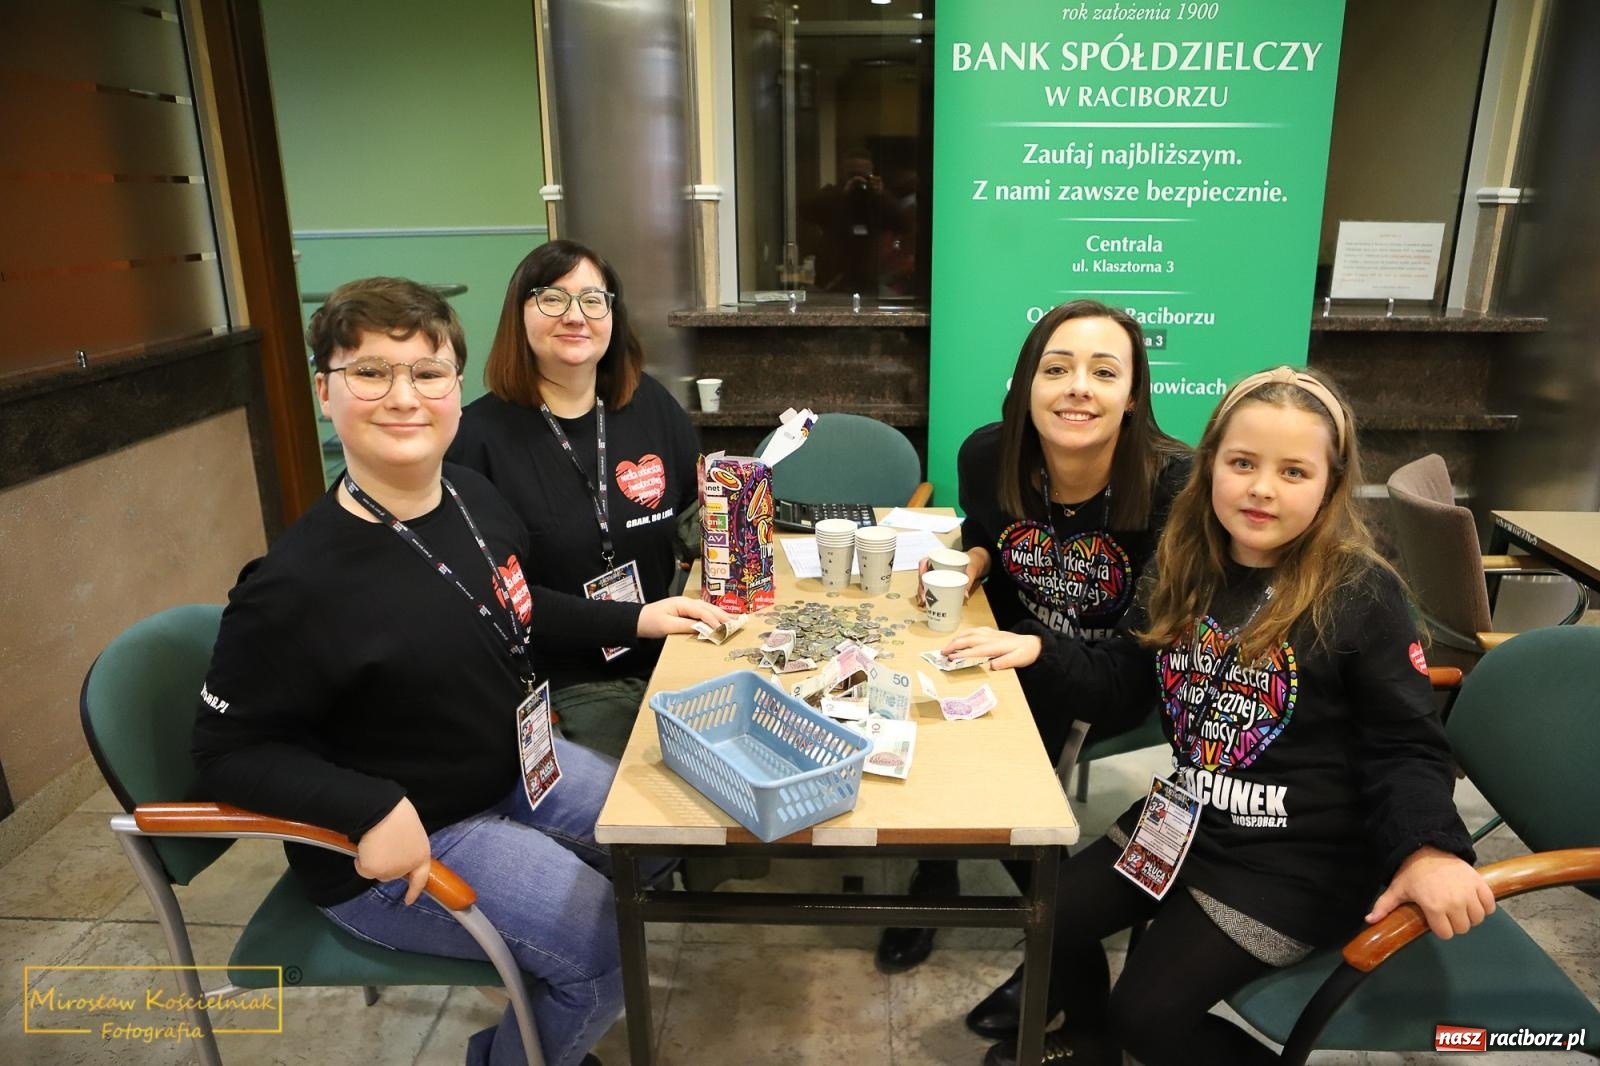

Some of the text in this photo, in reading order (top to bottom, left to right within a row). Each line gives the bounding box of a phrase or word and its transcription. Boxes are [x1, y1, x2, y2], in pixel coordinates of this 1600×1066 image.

[1062, 2, 1219, 20] rok założenia 1900
[952, 33, 1322, 71] BANK SPÓŁDZIELCZY
[1044, 86, 1228, 107] W RACIBORZU
[1022, 143, 1242, 170] Zaufaj najbliższym.
[973, 180, 1288, 207] Z nami zawsze bezpiecznie.
[1086, 235, 1163, 253] Centrala
[1072, 260, 1174, 273] ul. Klasztorna 3
[1125, 307, 1215, 325] Raciborzu
[1155, 335, 1163, 346] 3
[1011, 546, 1053, 568] wielka
[892, 673, 910, 688] 50
[1172, 756, 1289, 817] ACUNEK
